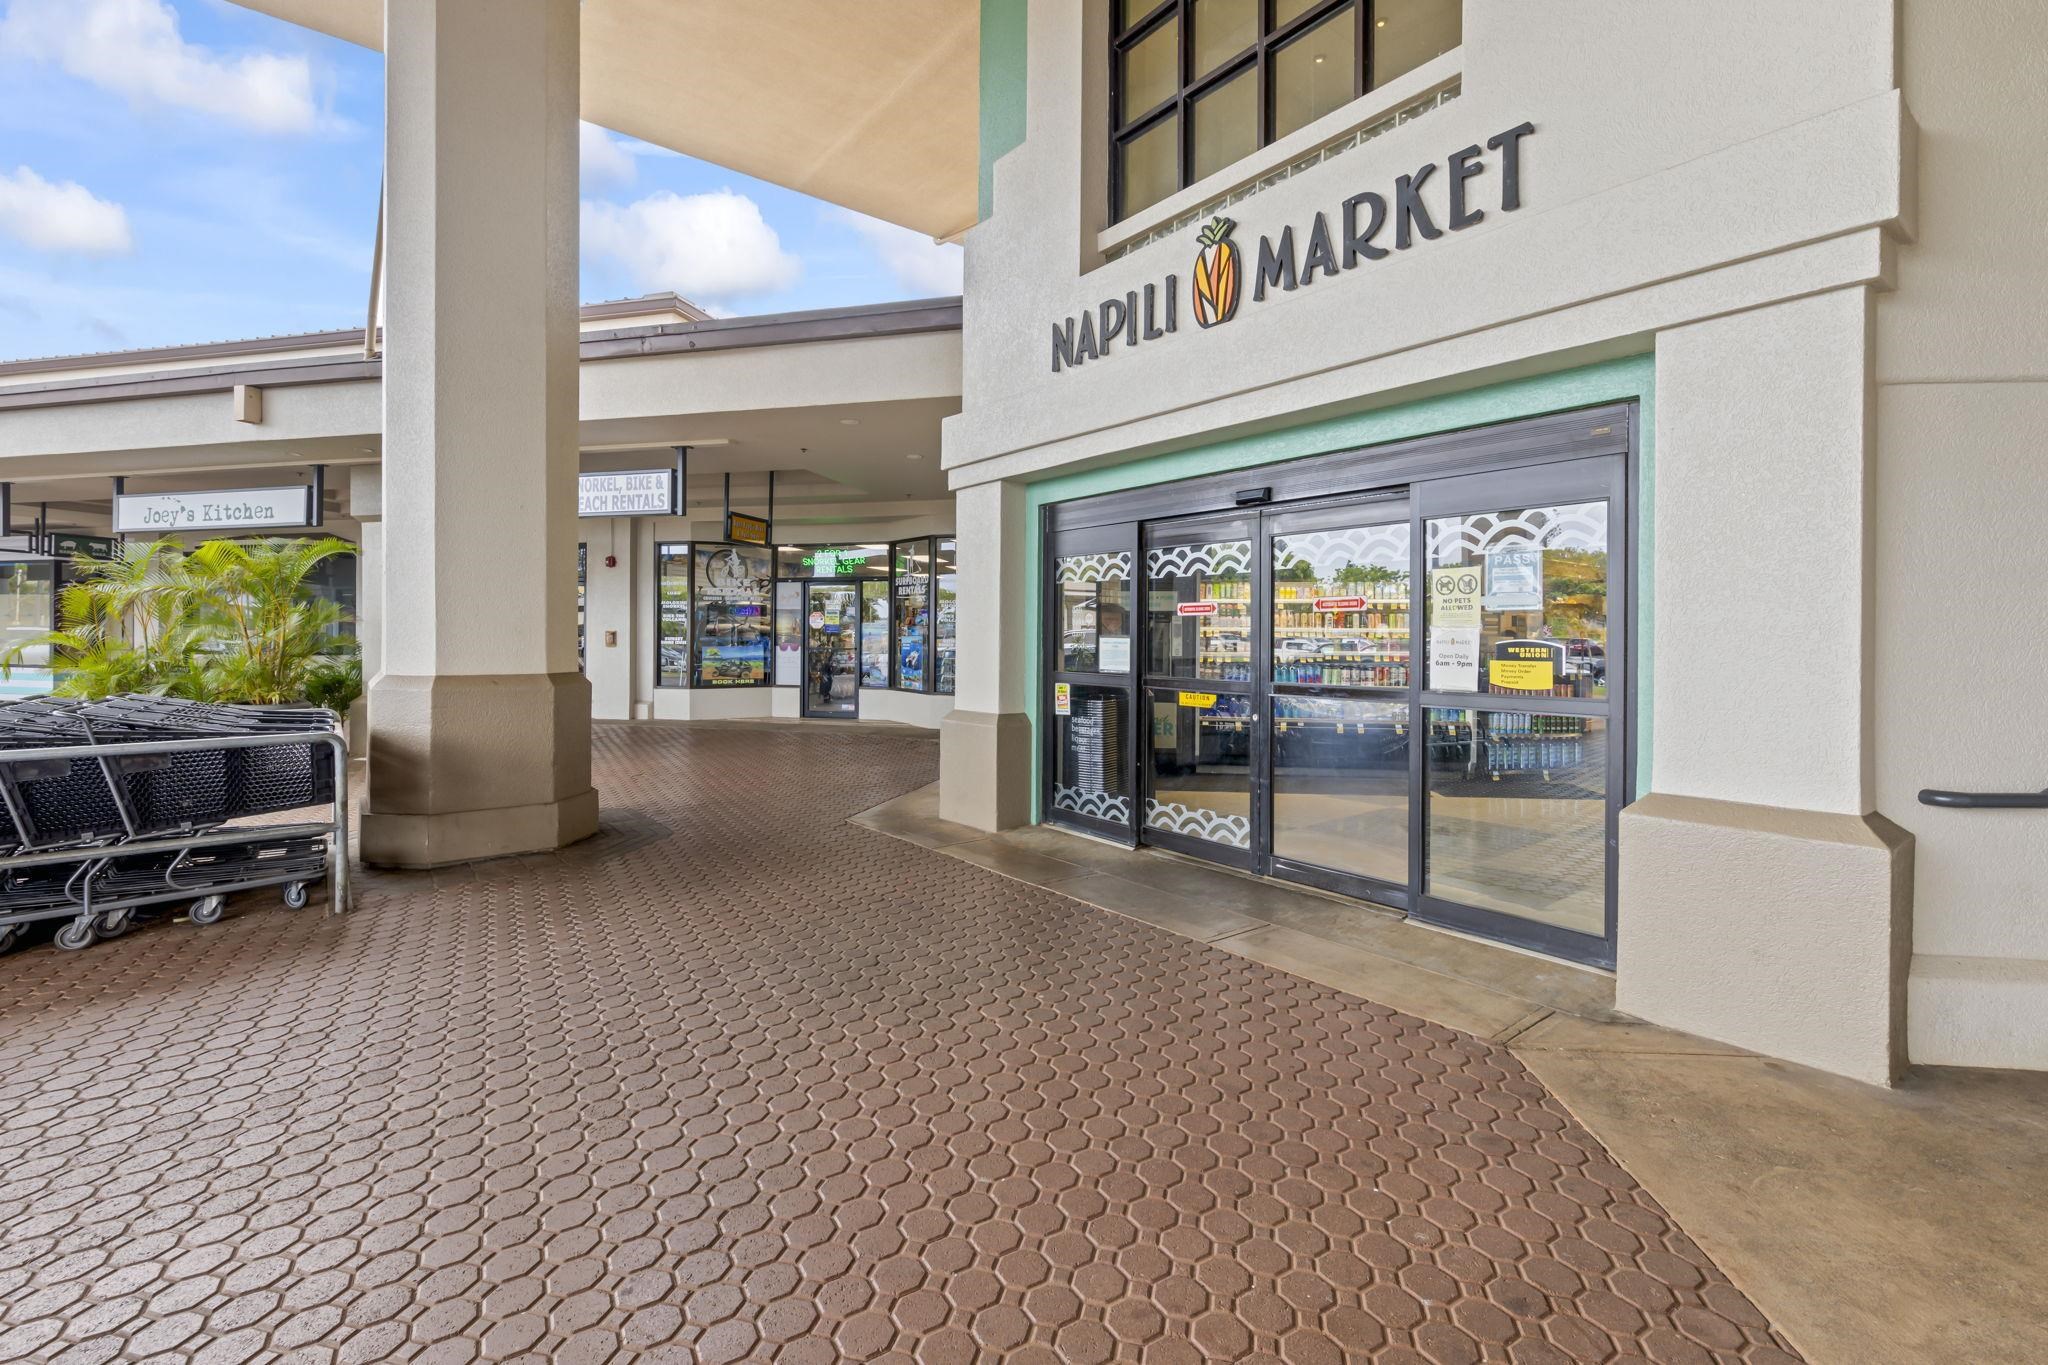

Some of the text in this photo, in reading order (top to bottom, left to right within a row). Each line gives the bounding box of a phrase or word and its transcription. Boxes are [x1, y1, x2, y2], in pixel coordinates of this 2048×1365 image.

[1051, 121, 1535, 373] NAPILI MARKET
[579, 474, 665, 494] NORKEL, BIKE &
[579, 492, 665, 512] EACH RENTALS
[143, 502, 275, 526] Joey's Kitchen
[802, 556, 866, 566] SNORKEL GEAR
[1494, 553, 1531, 566] PASS
[815, 564, 853, 574] RENTALS
[898, 584, 927, 595] RENTALS
[1456, 660, 1473, 668] 9pm
[1185, 693, 1210, 701] CAUTION
[1071, 716, 1094, 726] seafood
